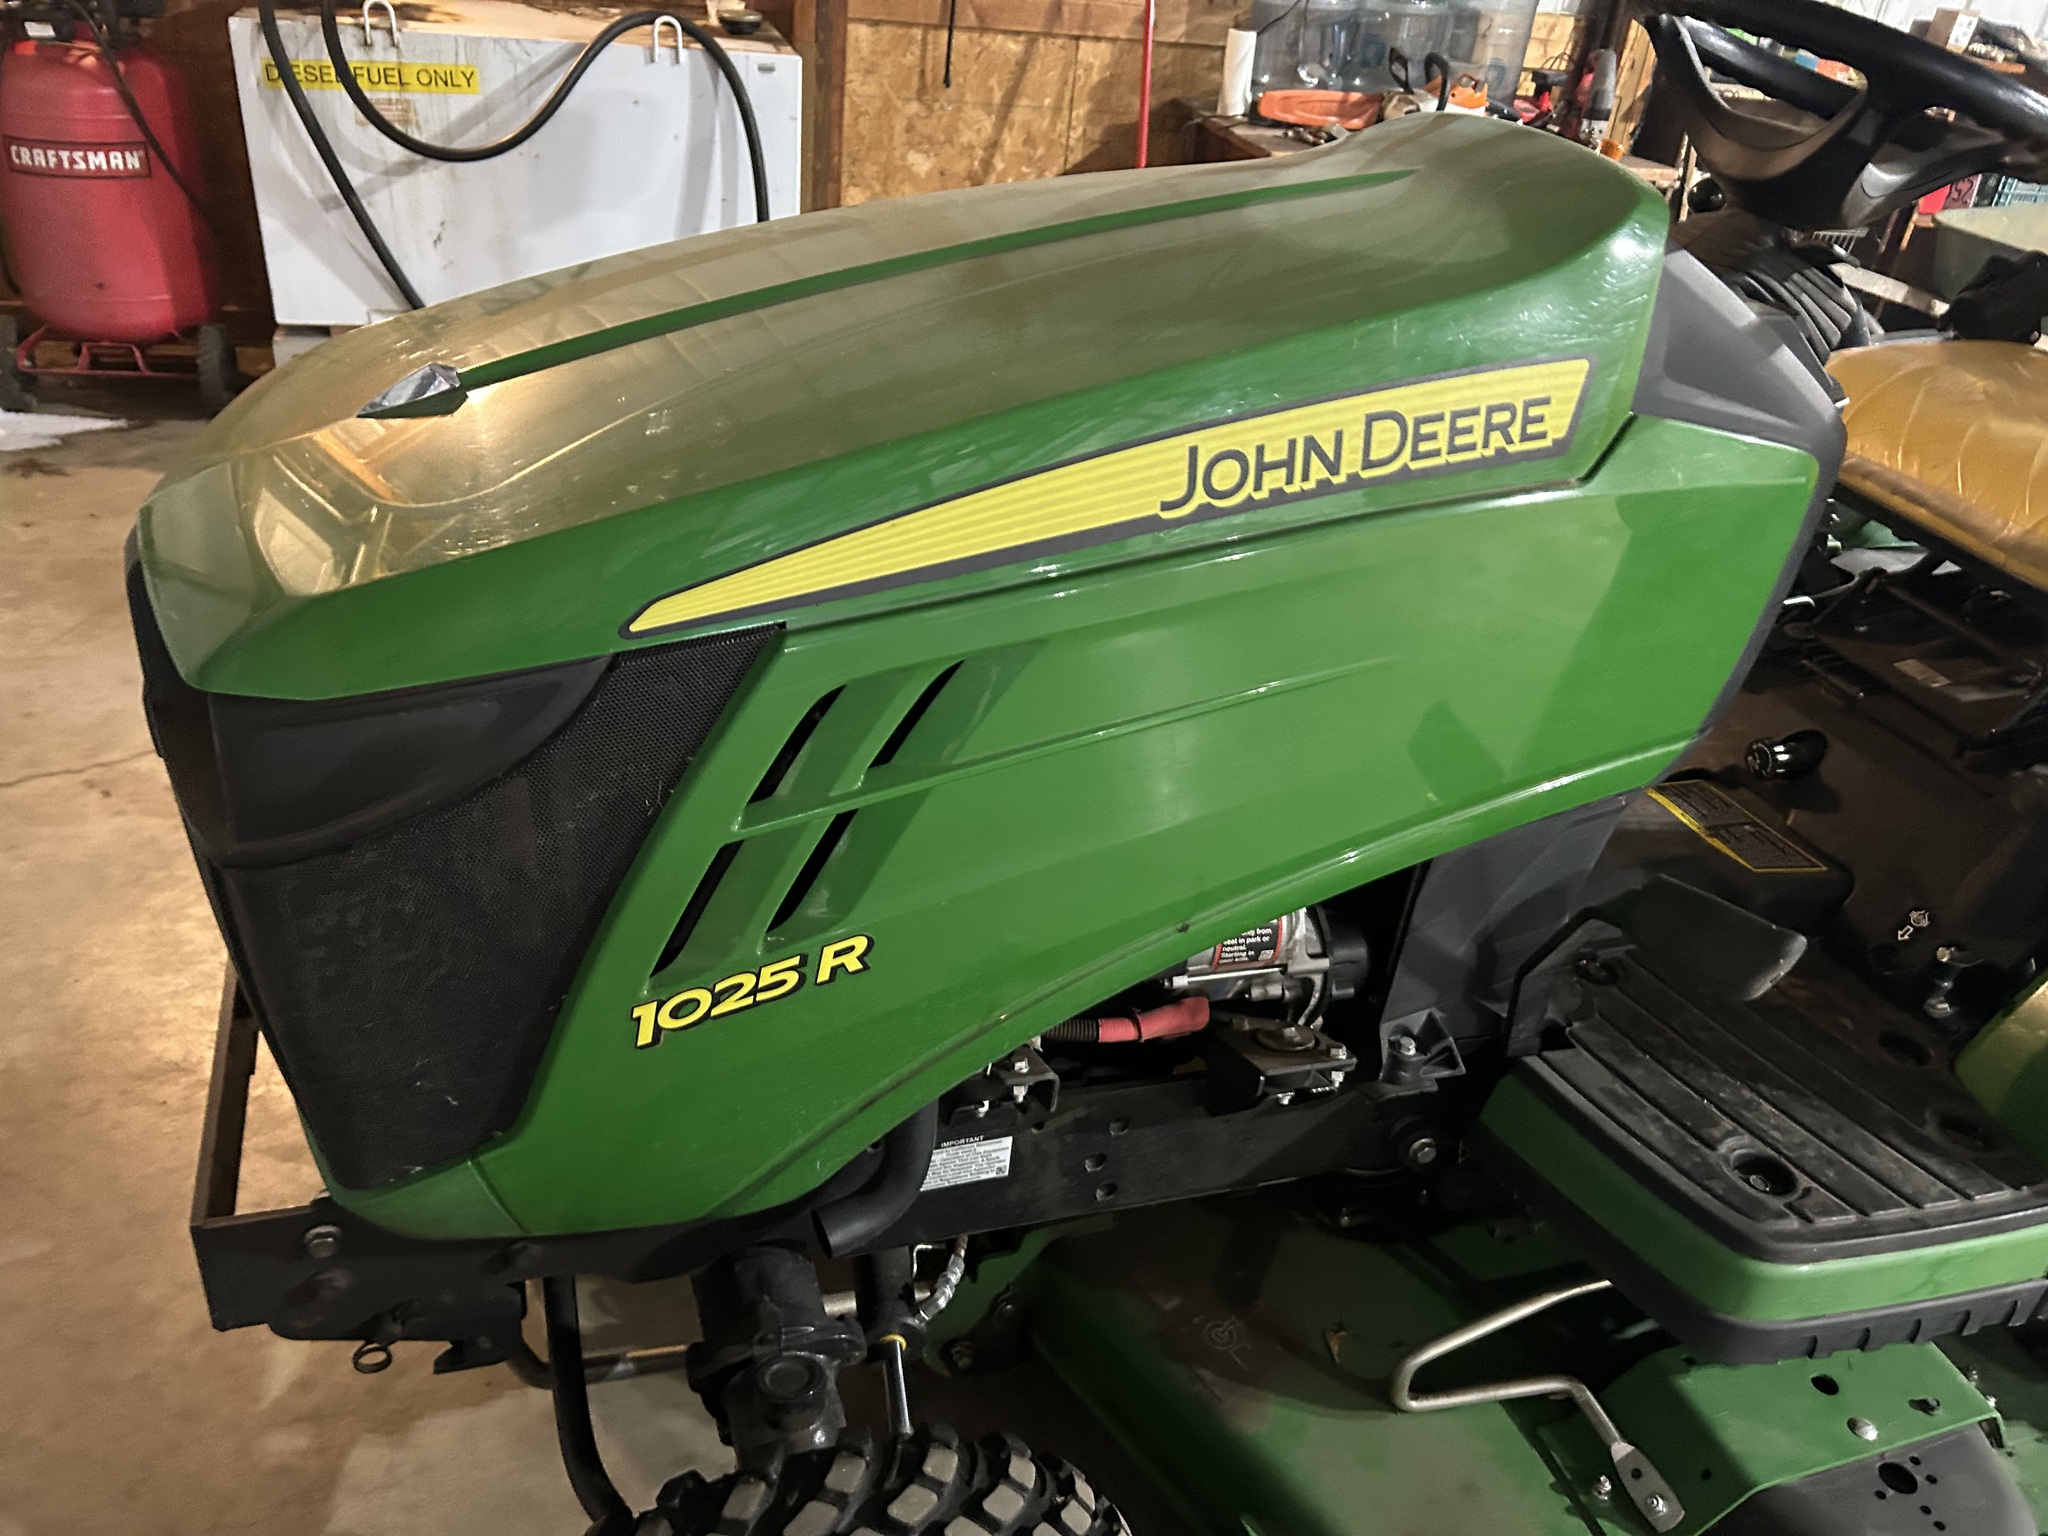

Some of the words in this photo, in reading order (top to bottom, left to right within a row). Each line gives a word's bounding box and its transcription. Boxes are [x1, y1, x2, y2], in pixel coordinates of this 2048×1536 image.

[265, 63, 342, 84] DESE
[352, 66, 411, 87] FUEL
[416, 69, 475, 88] ONLY
[10, 145, 141, 171] CRAFTSMAN
[1159, 429, 1344, 513] JOHN
[1360, 396, 1552, 472] DEERE
[632, 953, 806, 1048] 1025
[816, 934, 873, 985] R
[941, 1135, 985, 1148] IMPORTANT
